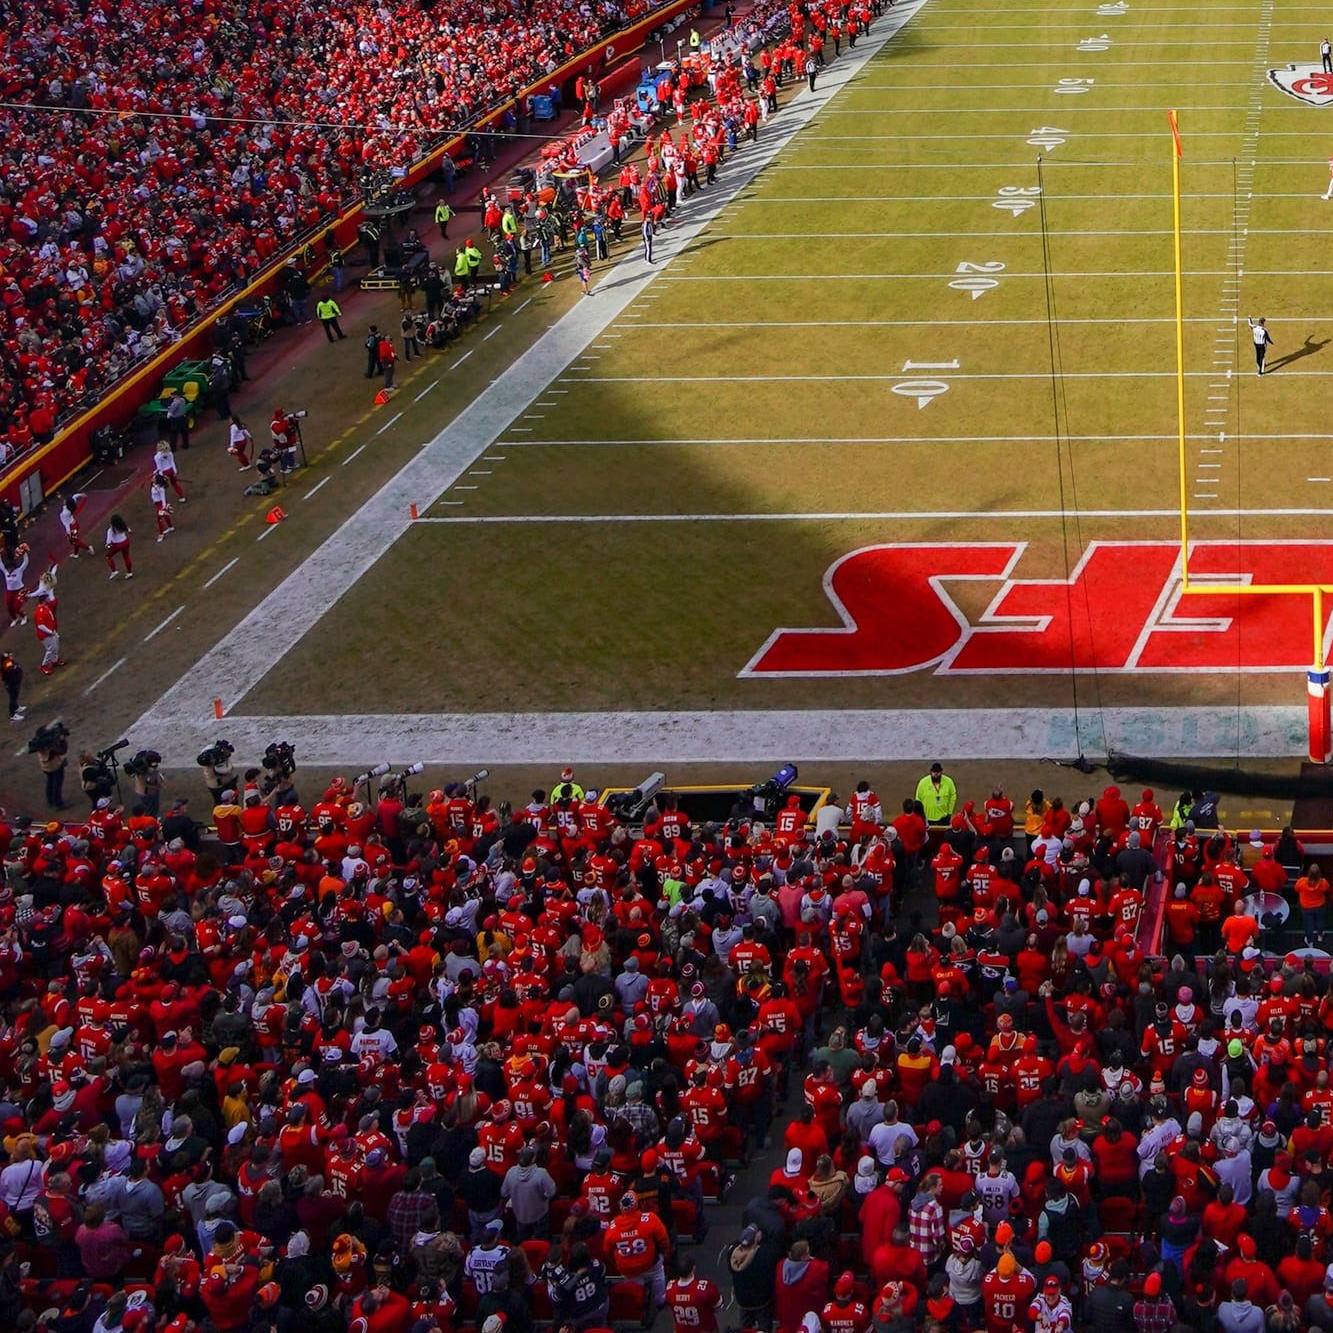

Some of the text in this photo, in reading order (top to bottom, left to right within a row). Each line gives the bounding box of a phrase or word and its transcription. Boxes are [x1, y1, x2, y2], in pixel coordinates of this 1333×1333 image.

[1053, 78, 1095, 94] 50
[1026, 126, 1070, 145] 40
[991, 186, 1042, 210] 30
[948, 261, 1006, 290] 20
[891, 358, 960, 397] 10
[279, 819, 293, 832] 87
[586, 819, 598, 831] 15
[662, 824, 681, 839] 89
[780, 818, 795, 832] 15
[1138, 817, 1153, 830] 87
[1219, 881, 1234, 894] 52
[1122, 904, 1138, 921] 87
[738, 1066, 758, 1087] 87
[513, 1100, 533, 1118] 91
[690, 1107, 708, 1126] 15
[487, 1145, 504, 1163] 15
[983, 1195, 1005, 1209] 58
[620, 1230, 639, 1239] MILLER
[616, 1239, 647, 1257] 58
[575, 1282, 597, 1303] 88
[675, 1294, 691, 1303] BERRY
[993, 1293, 1016, 1302] PACHECO
[673, 1305, 701, 1327] 29
[993, 1302, 1015, 1319] 10
